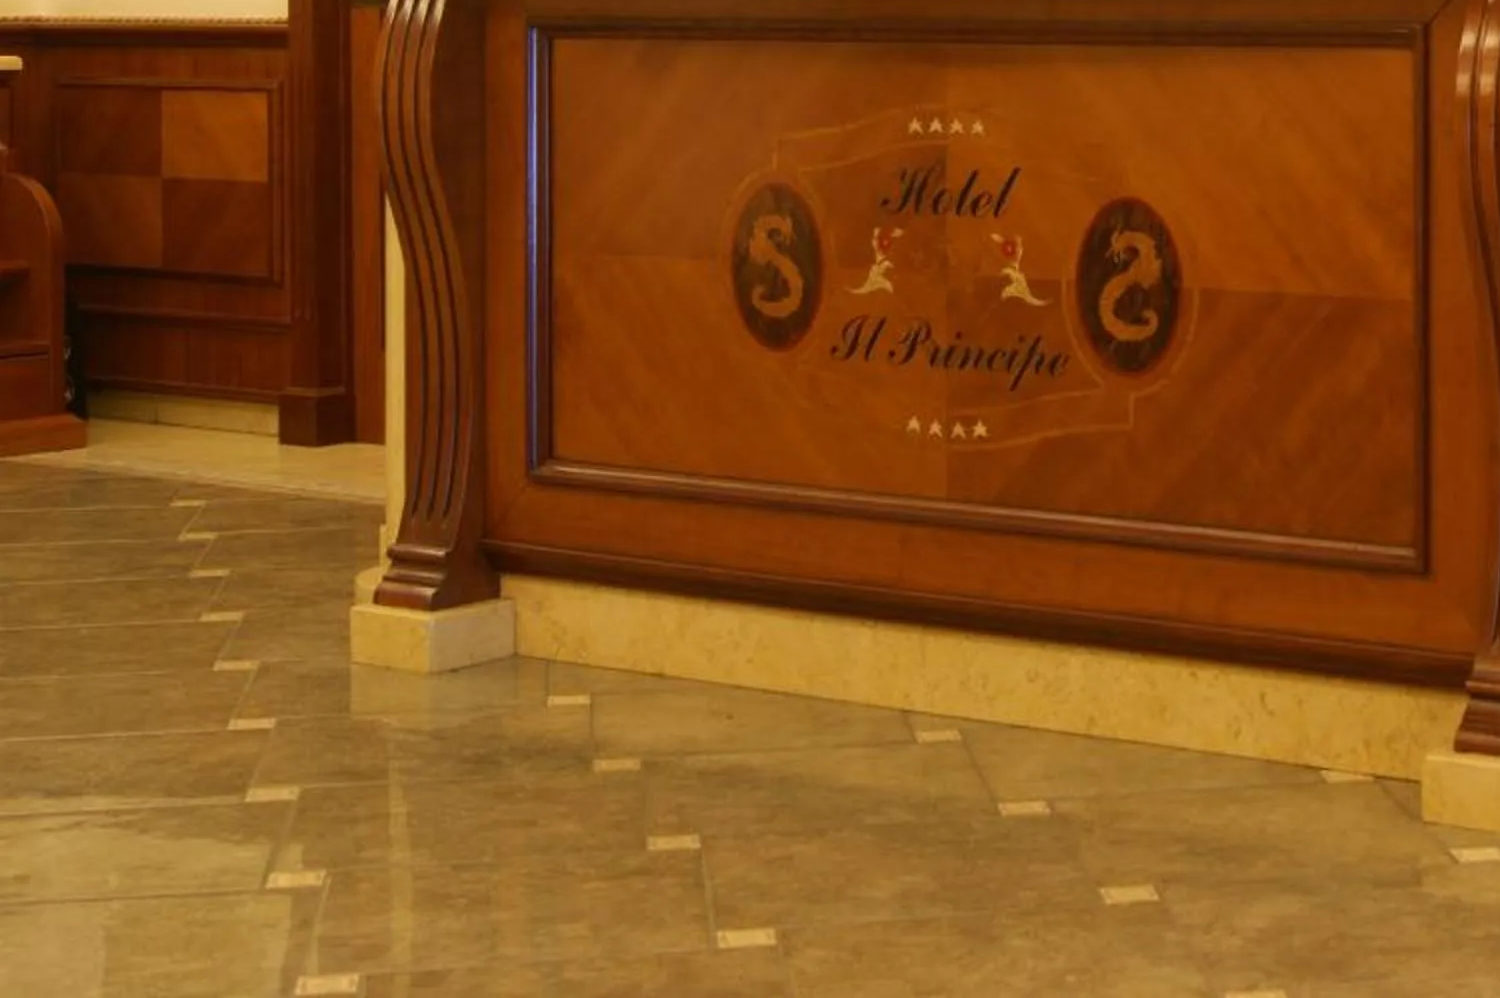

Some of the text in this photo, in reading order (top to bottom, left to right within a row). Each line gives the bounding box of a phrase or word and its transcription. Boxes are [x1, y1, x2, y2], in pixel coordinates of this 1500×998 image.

[880, 166, 1022, 219] Hotel
[830, 313, 1072, 391] Il Principe
